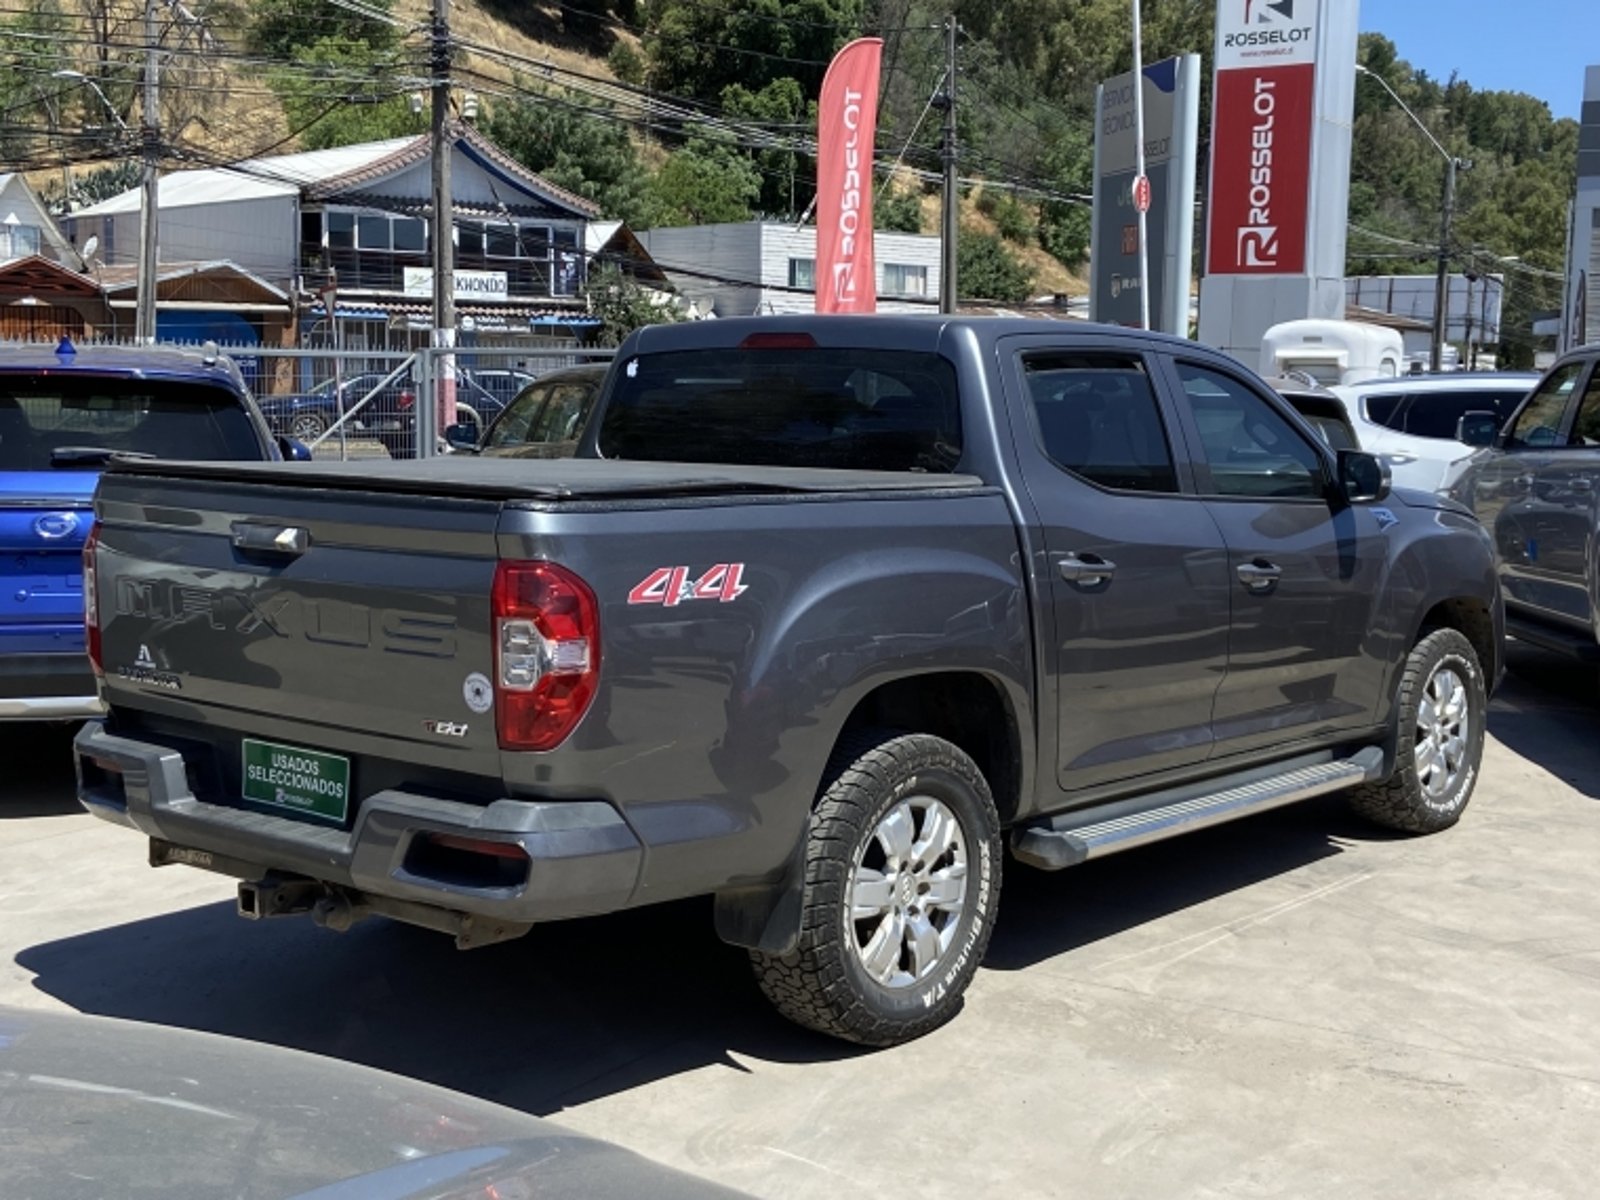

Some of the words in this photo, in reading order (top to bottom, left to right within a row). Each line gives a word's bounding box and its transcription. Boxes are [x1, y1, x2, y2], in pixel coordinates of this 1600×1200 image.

[1224, 26, 1312, 48] ROSSELOT
[1248, 76, 1277, 225] ROSSELOT
[455, 276, 507, 293] KWONDO
[627, 563, 749, 607] 4x4
[271, 753, 320, 776] USADOS
[247, 763, 344, 799] SELECCIONADOS
